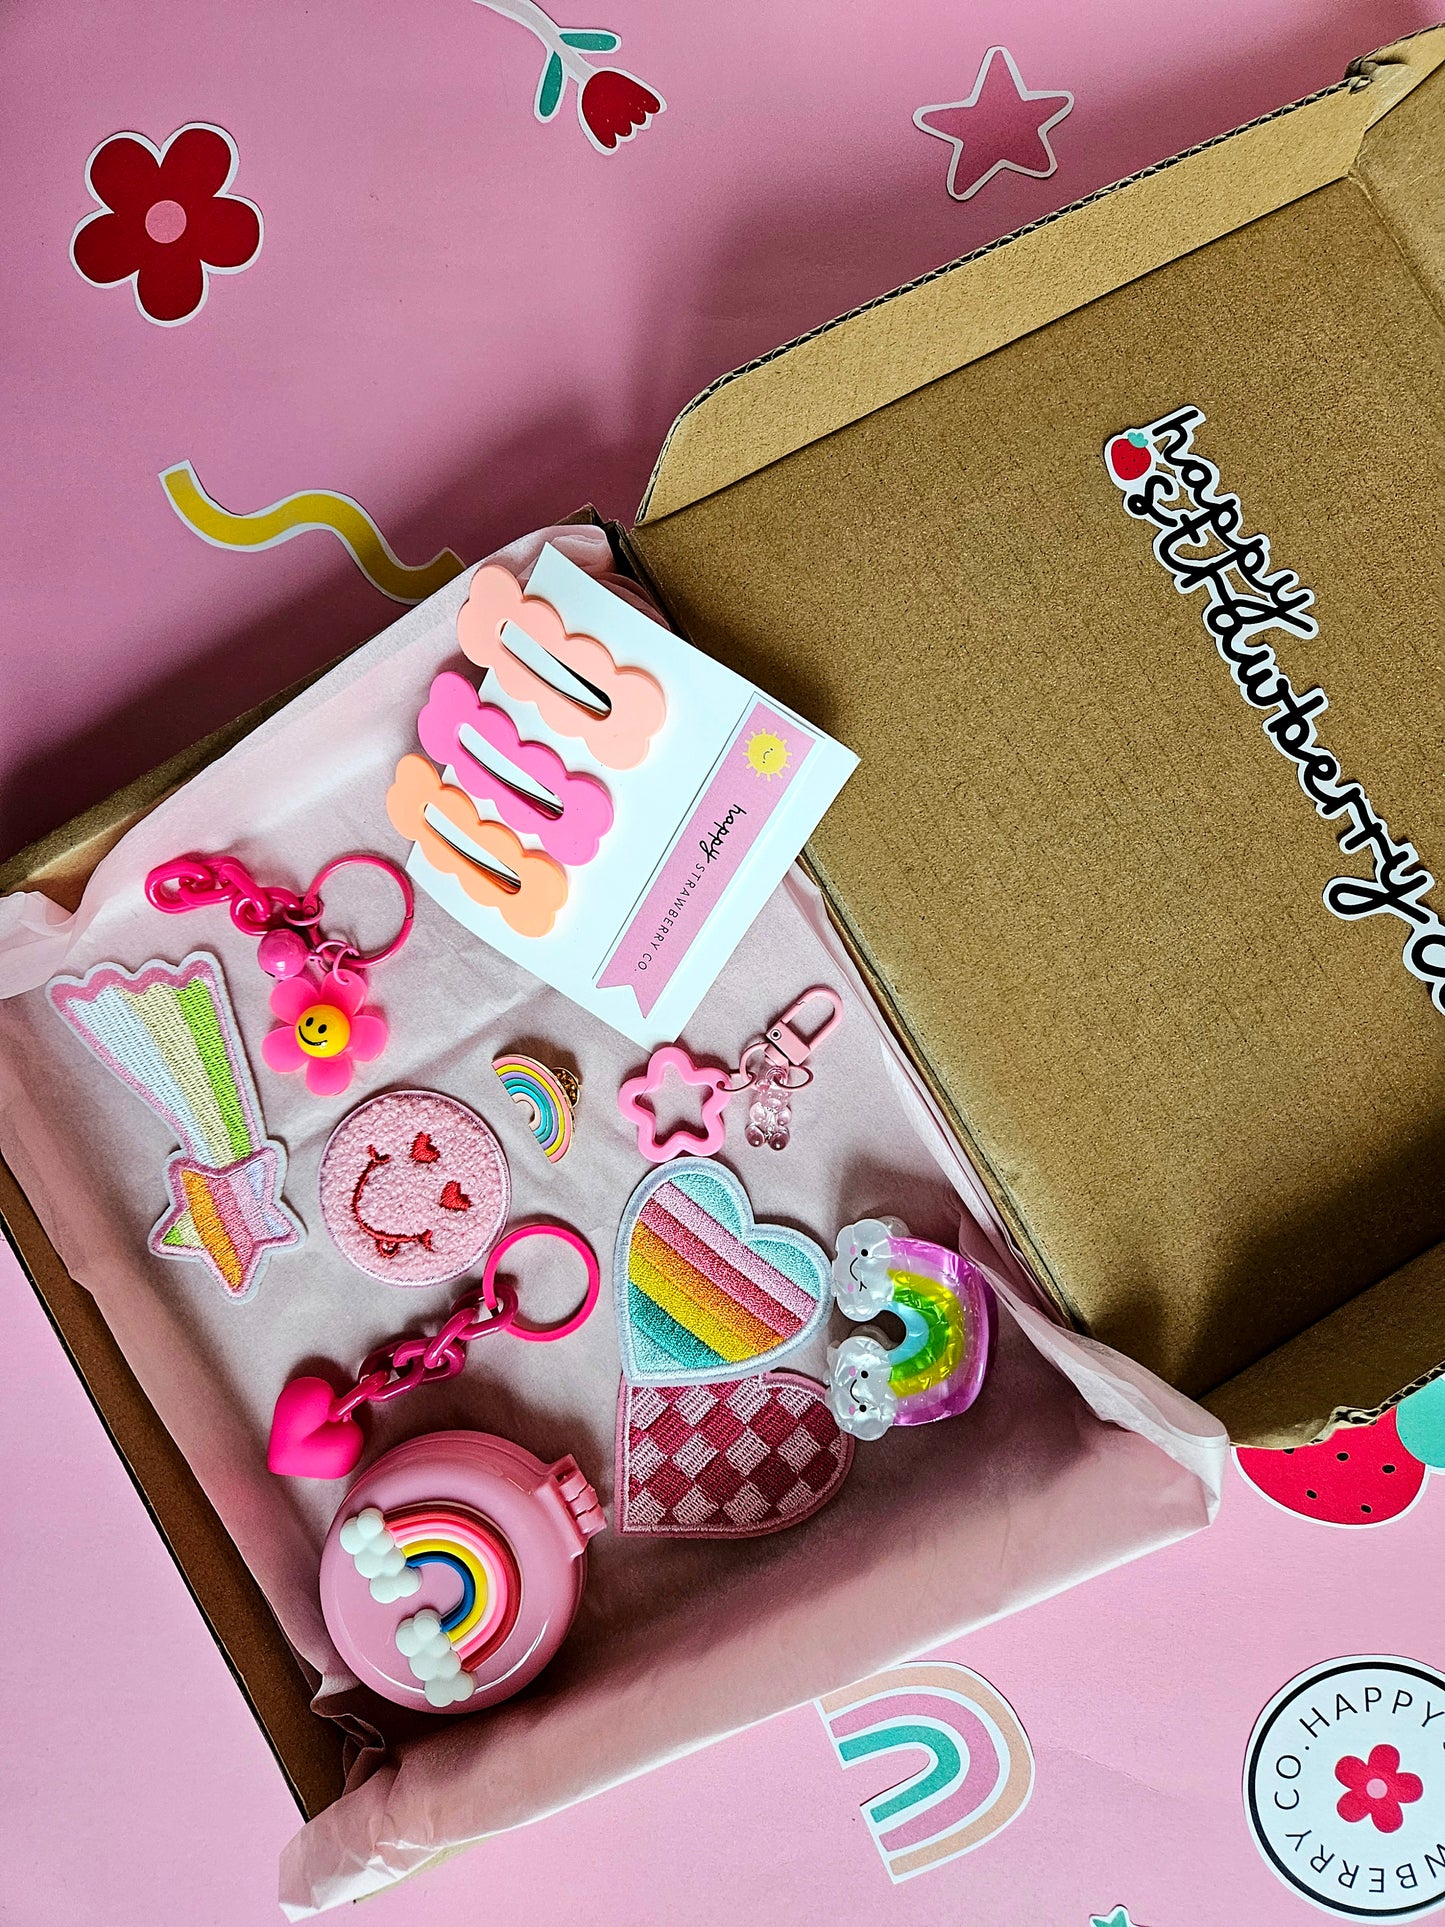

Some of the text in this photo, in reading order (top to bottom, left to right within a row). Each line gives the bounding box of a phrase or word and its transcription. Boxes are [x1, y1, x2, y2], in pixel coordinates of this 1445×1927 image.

[1152, 409, 1314, 633] happy
[1129, 474, 1430, 925] strawberry
[634, 804, 747, 972] happy STRAWBERRY CO.
[1274, 1687, 1445, 1893] HAPPY WBERRY CO.
